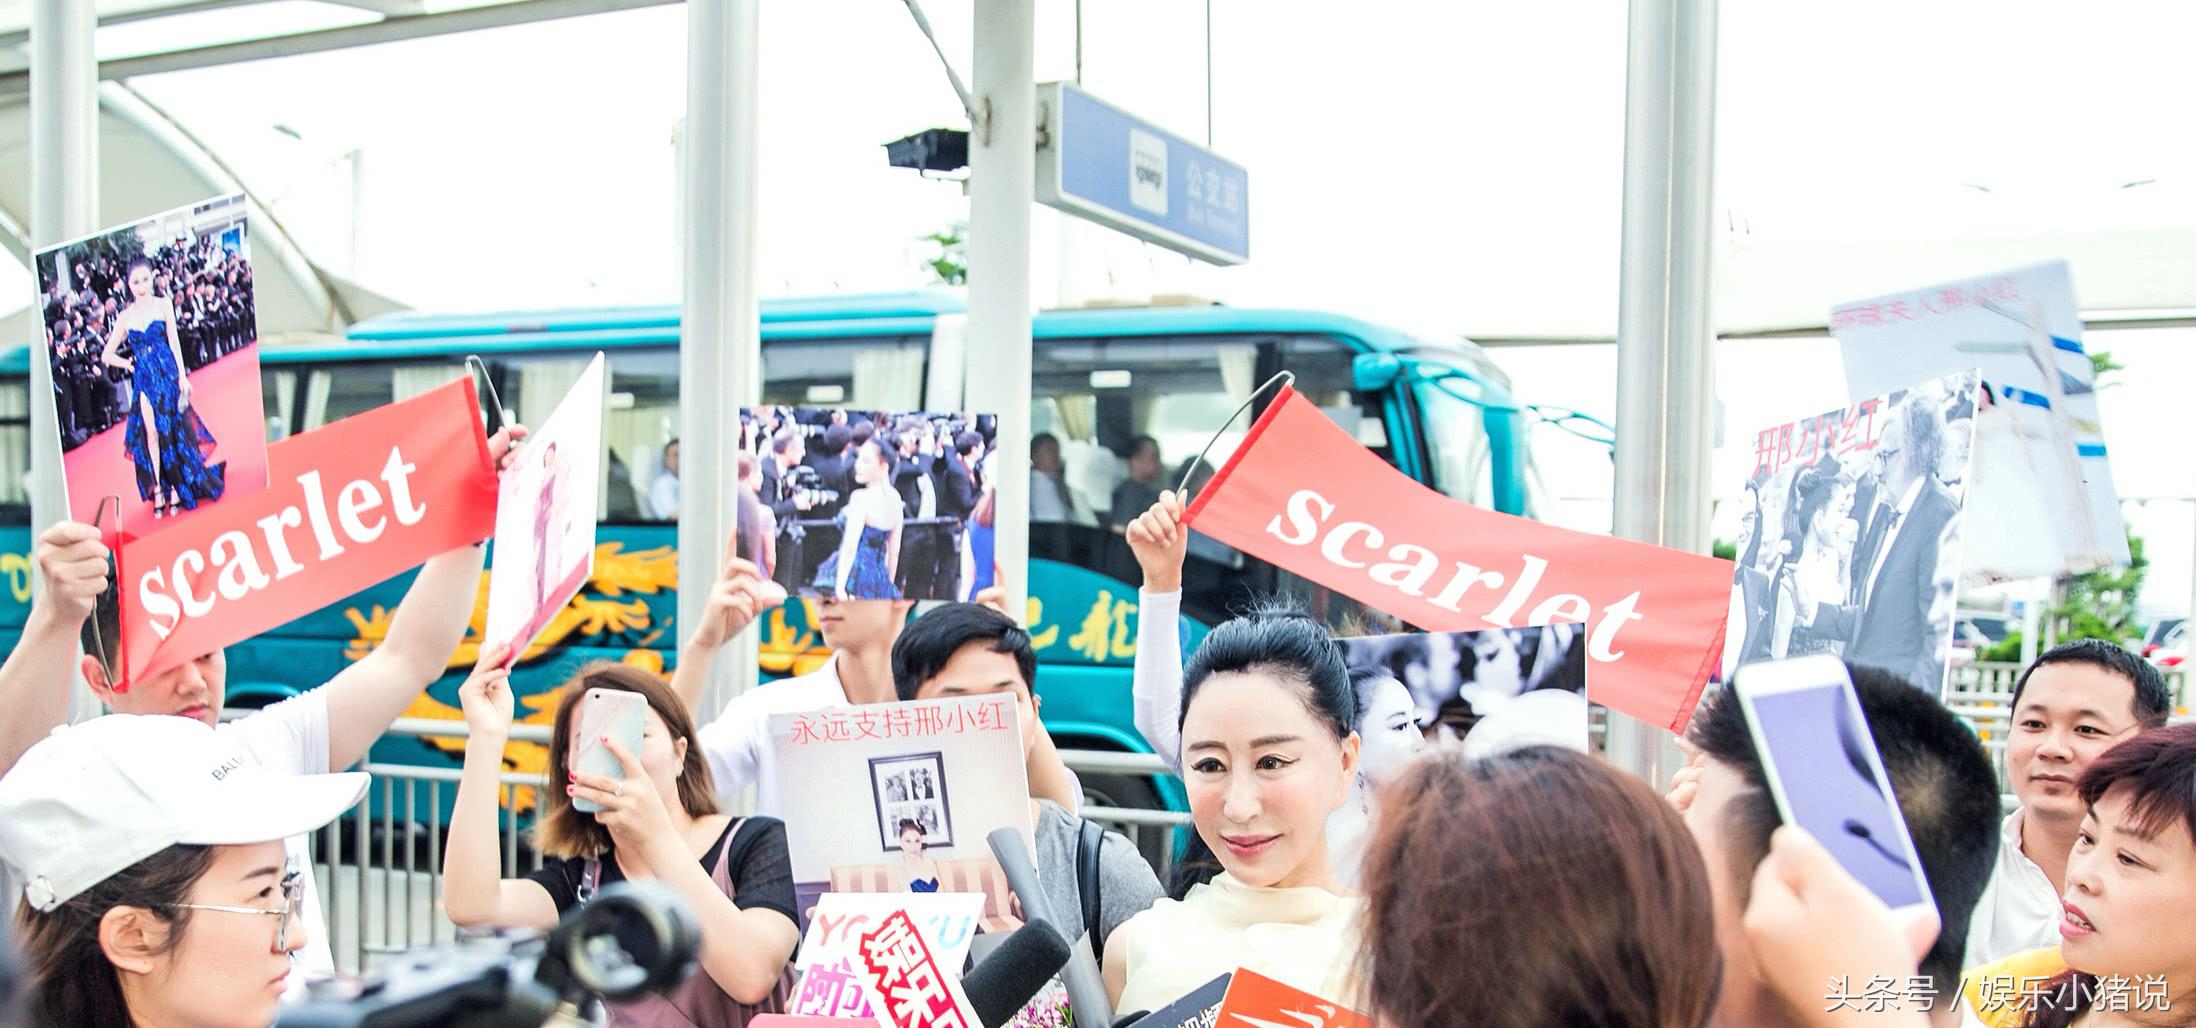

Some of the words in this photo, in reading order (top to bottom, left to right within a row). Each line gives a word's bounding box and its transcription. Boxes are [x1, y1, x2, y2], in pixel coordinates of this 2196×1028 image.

[1751, 399, 1884, 481] 邢小红
[139, 445, 426, 641] scarlet
[790, 702, 1009, 745] 永远支持邢小红
